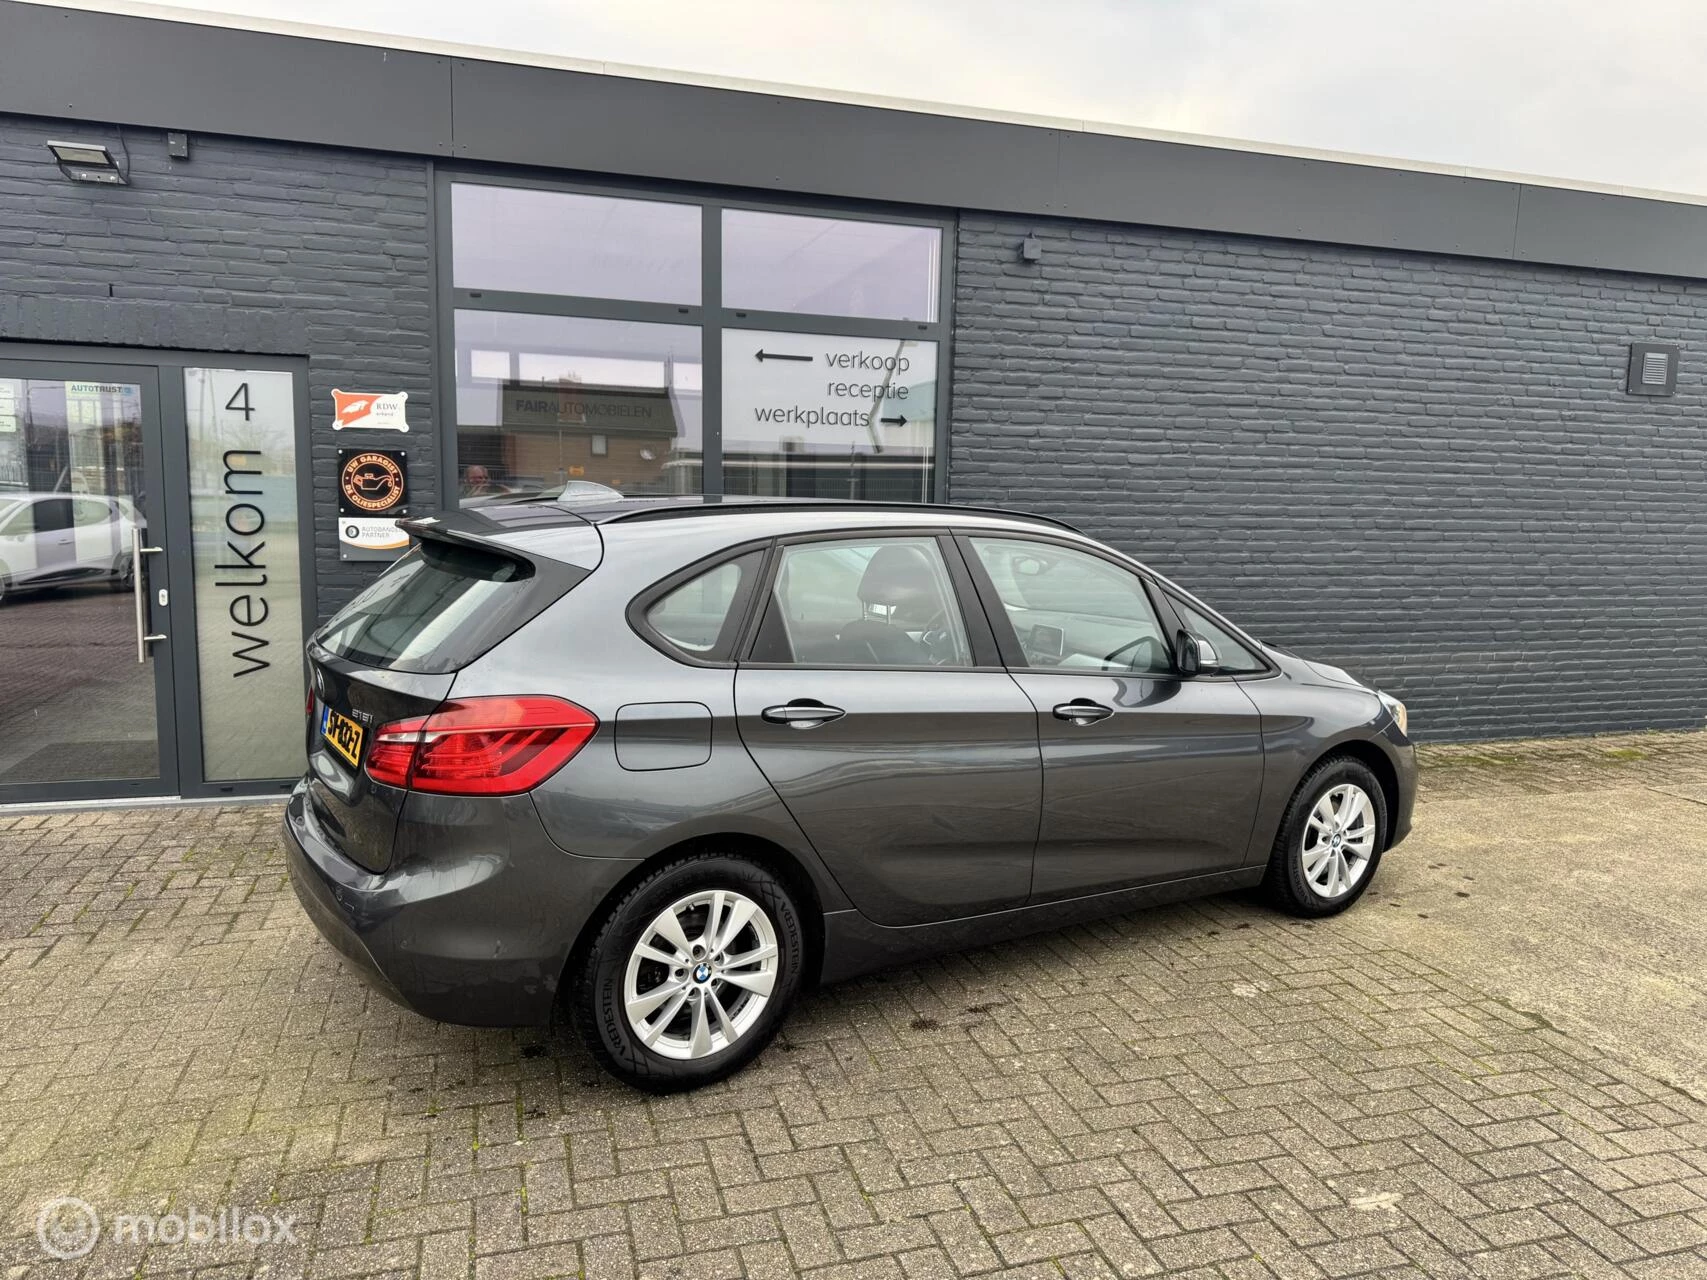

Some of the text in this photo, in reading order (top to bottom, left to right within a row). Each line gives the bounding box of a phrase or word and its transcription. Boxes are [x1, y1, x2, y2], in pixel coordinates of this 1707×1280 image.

[826, 351, 910, 375] verkoop
[72, 384, 122, 393] AUTOTRUST
[828, 382, 909, 402] receptie
[225, 382, 256, 422] 4
[755, 405, 871, 428] werkplaats
[347, 455, 398, 474] UW GARAGIST
[345, 484, 401, 508] DE OLIESPECIALIST
[214, 449, 271, 678] welkom
